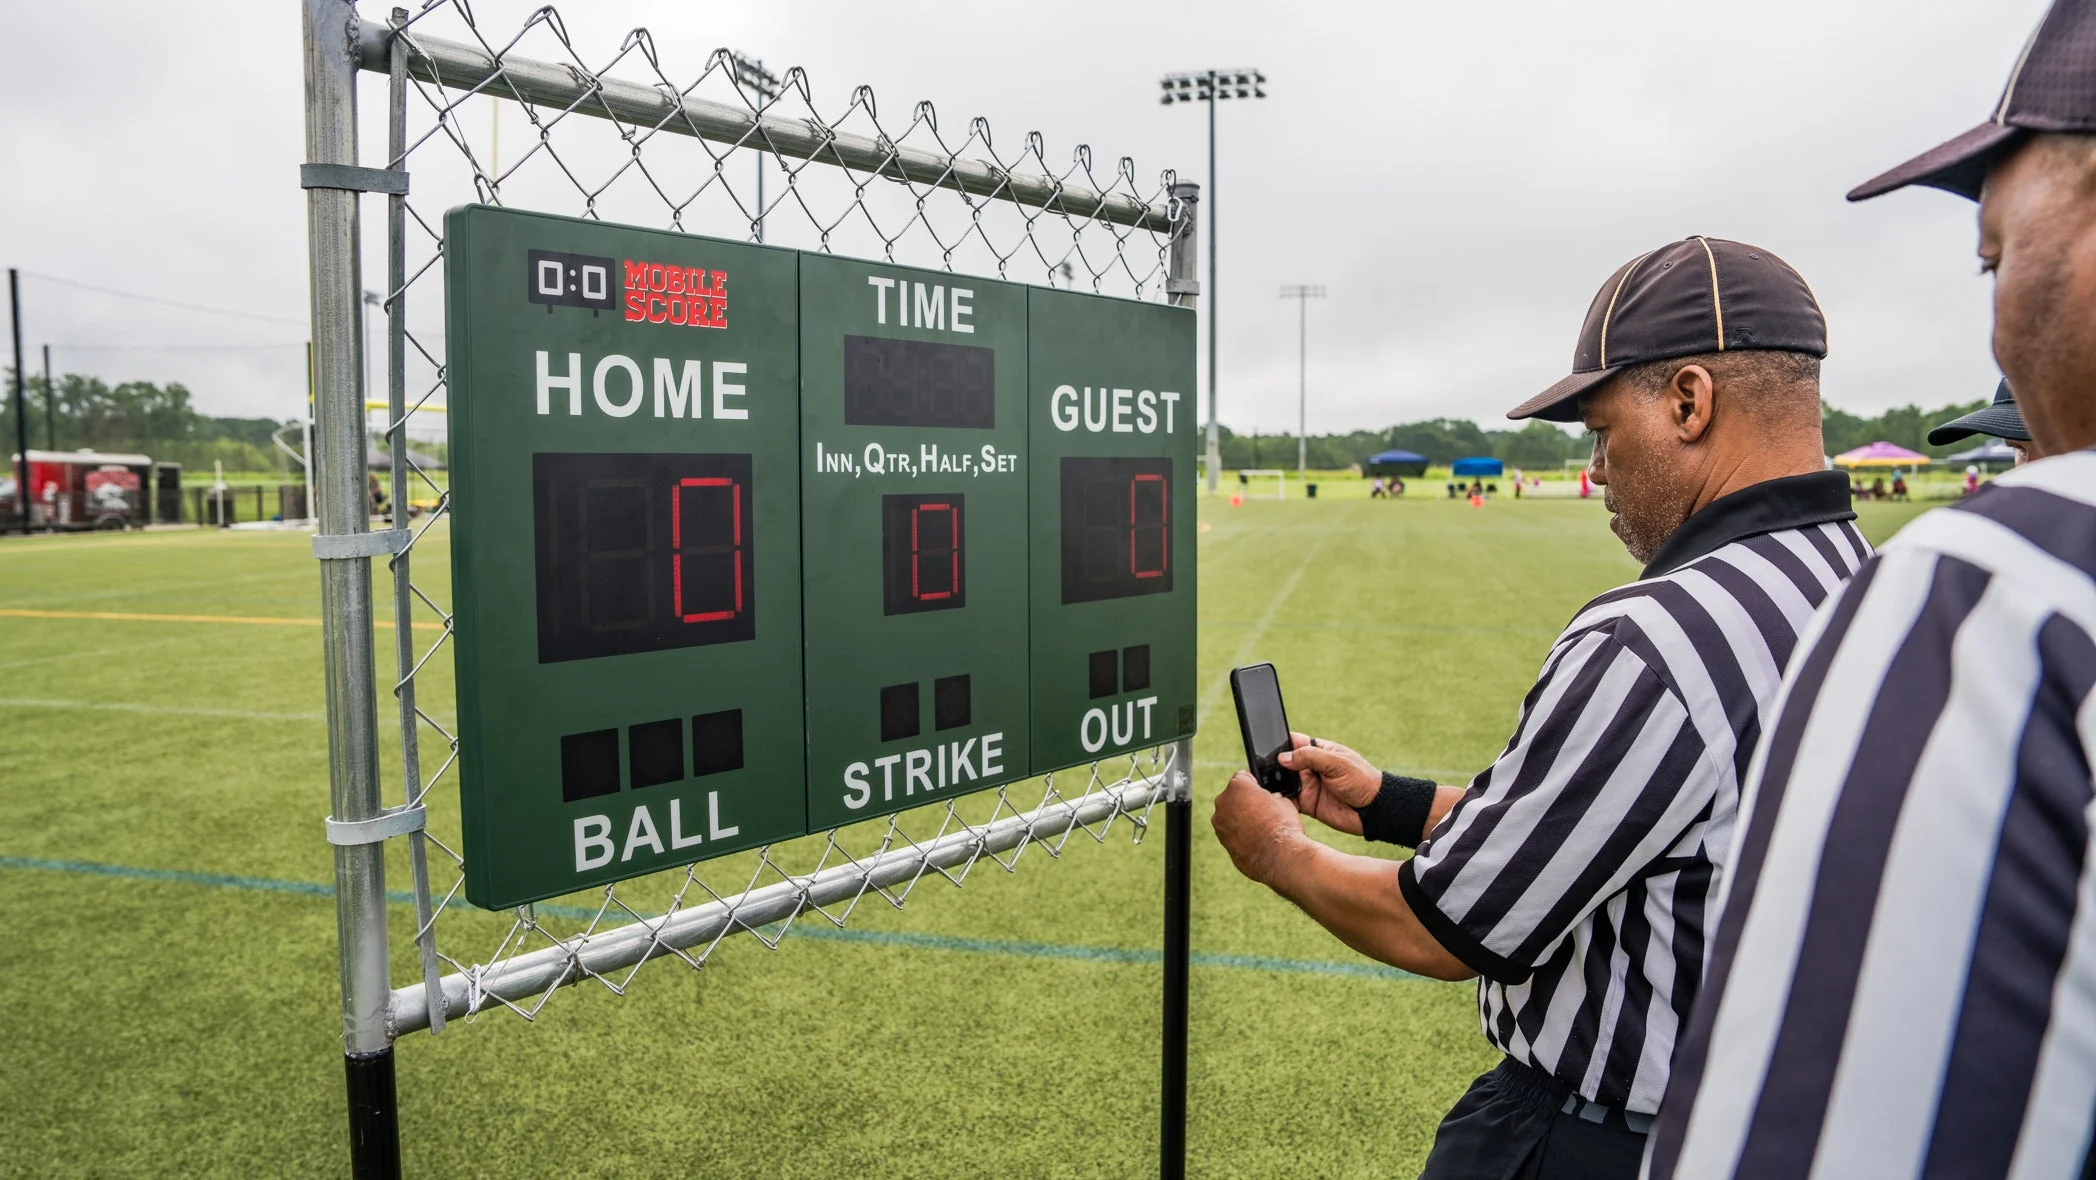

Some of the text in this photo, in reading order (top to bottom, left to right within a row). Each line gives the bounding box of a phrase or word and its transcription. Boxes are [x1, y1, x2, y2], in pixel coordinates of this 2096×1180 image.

[624, 260, 727, 299] MOBILE
[625, 290, 727, 329] SCORE
[869, 275, 976, 334] TIME
[535, 350, 749, 420] HOME
[1050, 384, 1181, 434] GUEST
[672, 477, 742, 623] 0
[911, 503, 958, 600] 0
[1131, 474, 1167, 578] 0
[1080, 696, 1158, 754] OUT
[843, 732, 1004, 810] STRIKE
[573, 790, 739, 873] BALL
